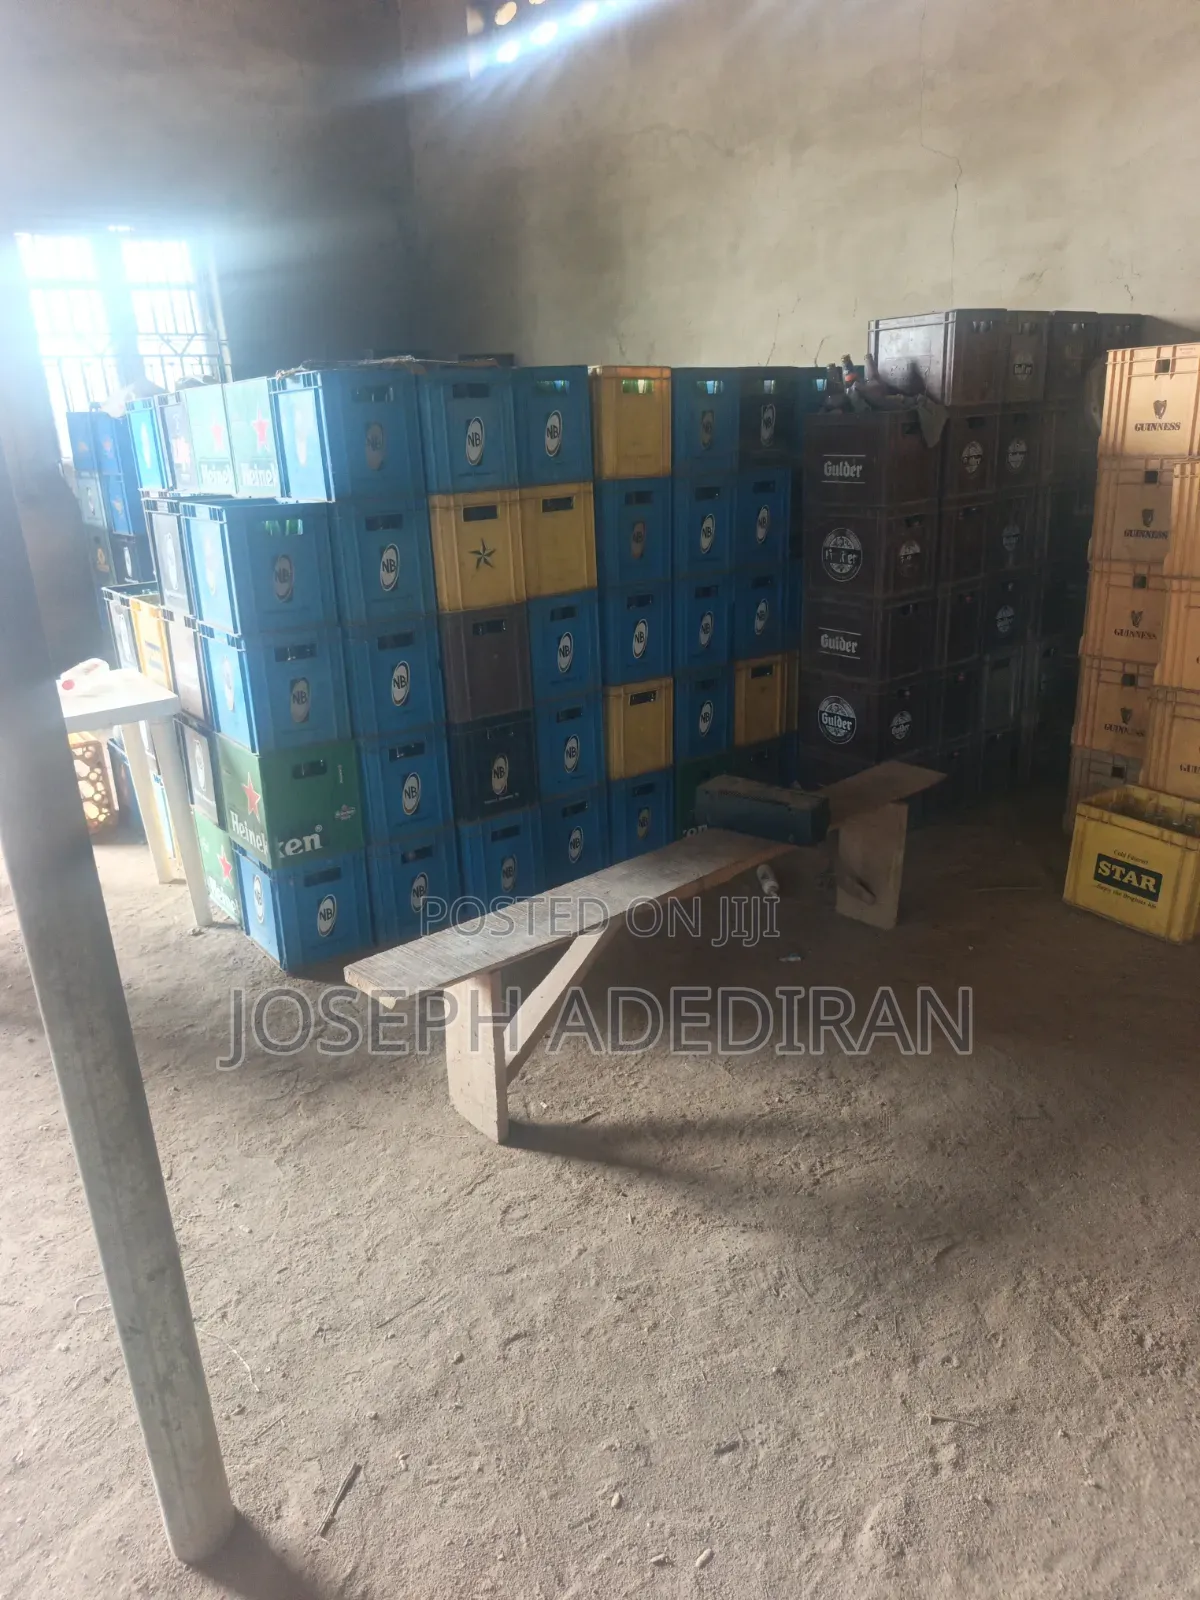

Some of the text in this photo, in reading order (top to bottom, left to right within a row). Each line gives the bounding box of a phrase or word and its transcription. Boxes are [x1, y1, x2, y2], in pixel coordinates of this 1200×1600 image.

[546, 424, 560, 439] NB
[1134, 422, 1181, 432] GUINNESS
[468, 432, 481, 447] NB
[823, 460, 863, 478] Gulder
[702, 526, 713, 539] NB
[382, 559, 396, 573] NB
[634, 631, 645, 643] NB
[1114, 628, 1157, 640] GUINNESS
[820, 633, 858, 653] Gulder
[559, 645, 571, 658] NB
[393, 675, 407, 690] NB
[292, 690, 308, 704] NB
[821, 712, 853, 731] Gulder
[566, 747, 577, 759] NB
[493, 766, 506, 780] NB
[404, 784, 418, 799] NB
[570, 838, 581, 851] NB
[1098, 860, 1157, 893] STAR
[412, 884, 425, 898] NB
[319, 907, 333, 921] NB
